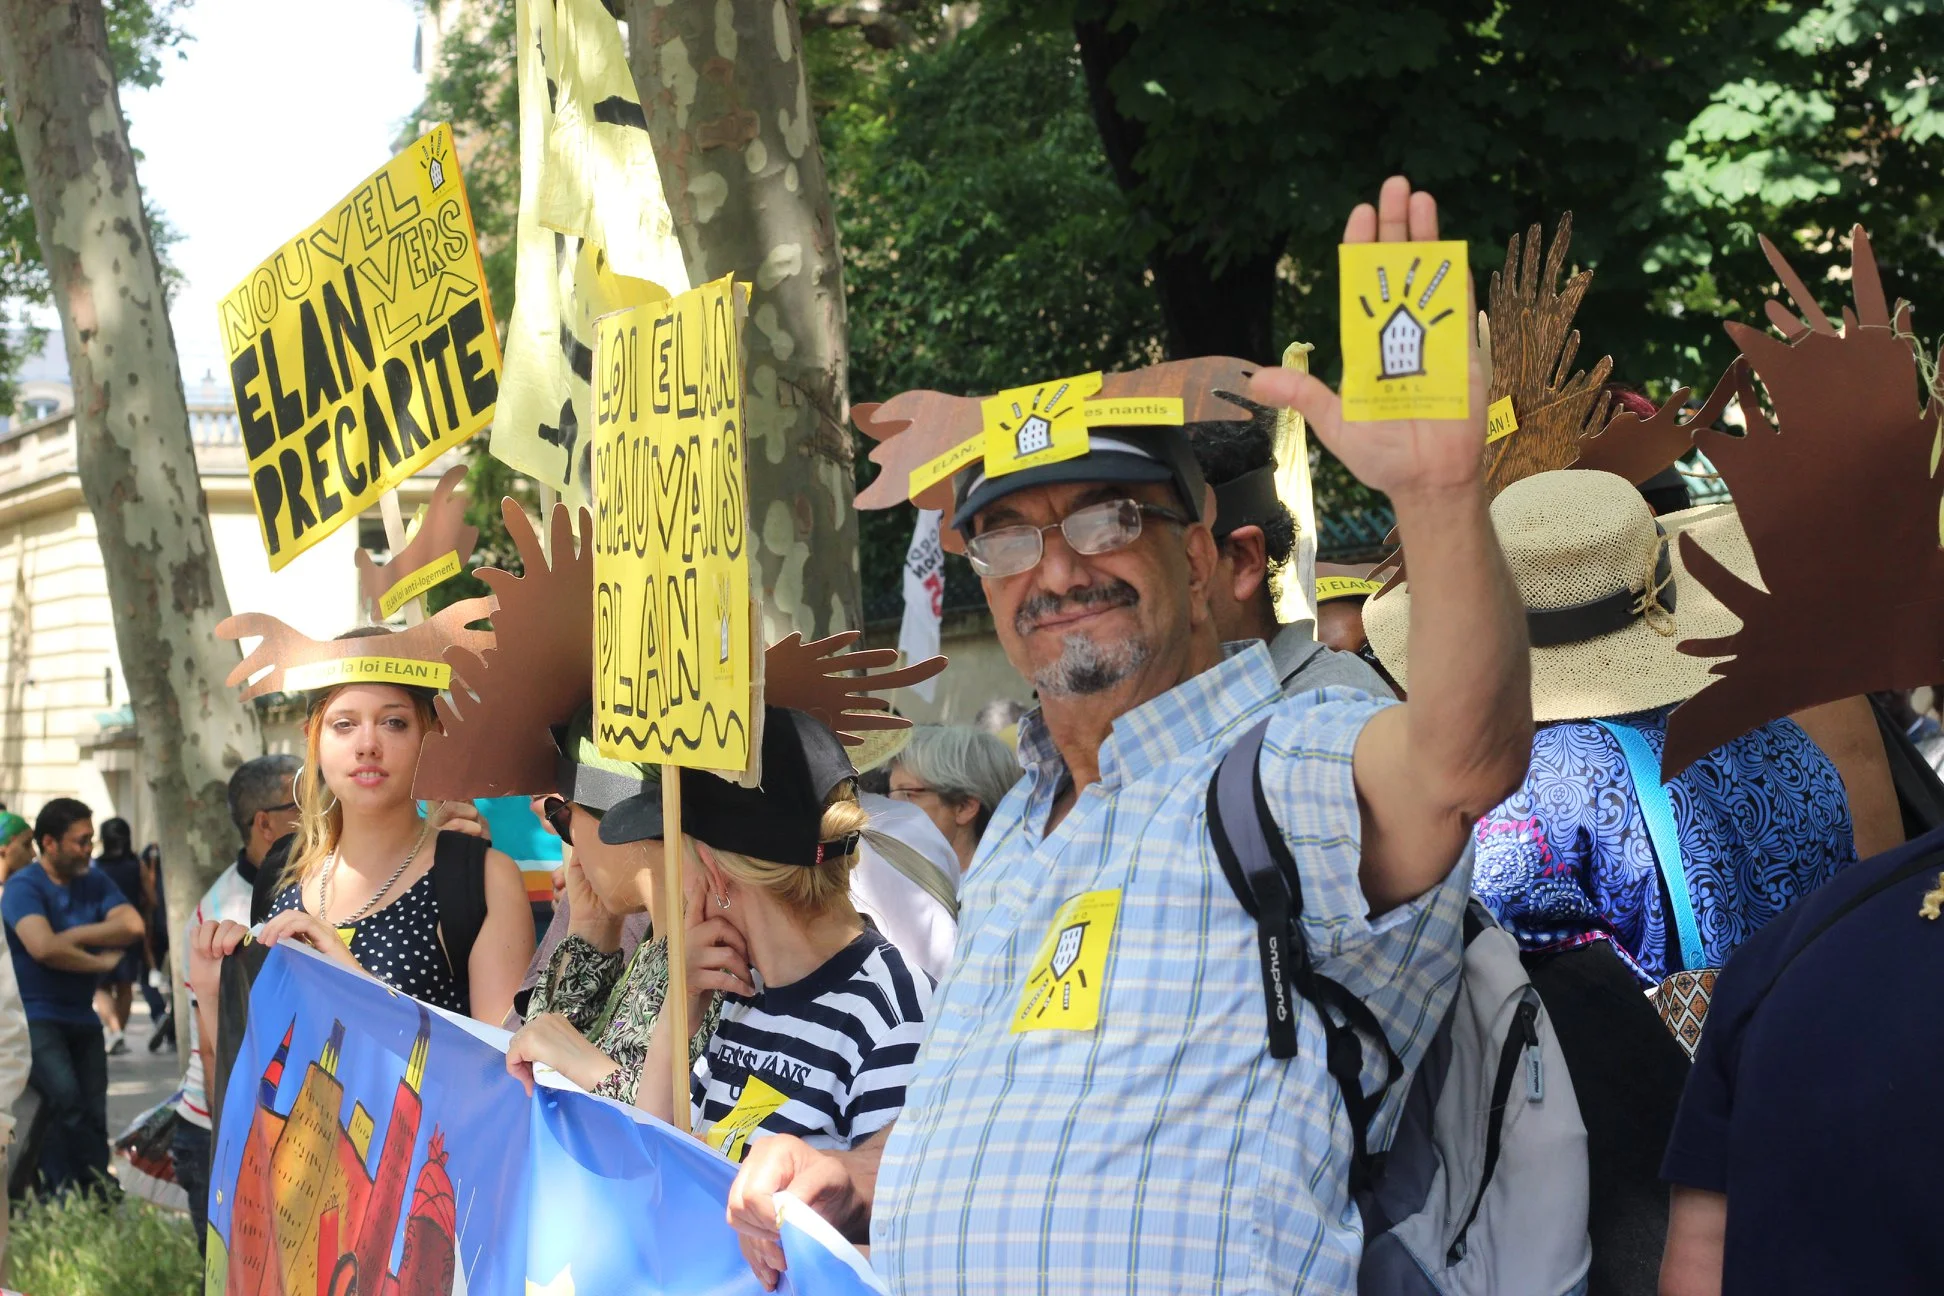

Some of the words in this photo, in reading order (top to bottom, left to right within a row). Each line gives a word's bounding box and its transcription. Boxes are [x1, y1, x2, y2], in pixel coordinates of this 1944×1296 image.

[221, 170, 421, 355] NOUVEL
[357, 198, 469, 304] VERS
[229, 263, 378, 461] ELAN
[253, 297, 500, 556] PRECARITE
[598, 324, 639, 427] LOI
[652, 296, 738, 421] ELAN
[1109, 404, 1169, 415] nantis
[595, 419, 743, 564] MAUVAIS
[404, 562, 455, 596] anti-logement
[1330, 580, 1374, 590] ELAN
[341, 661, 355, 675] la
[359, 661, 380, 674] loi
[384, 661, 428, 678] ELAN
[598, 568, 701, 722] PLAN
